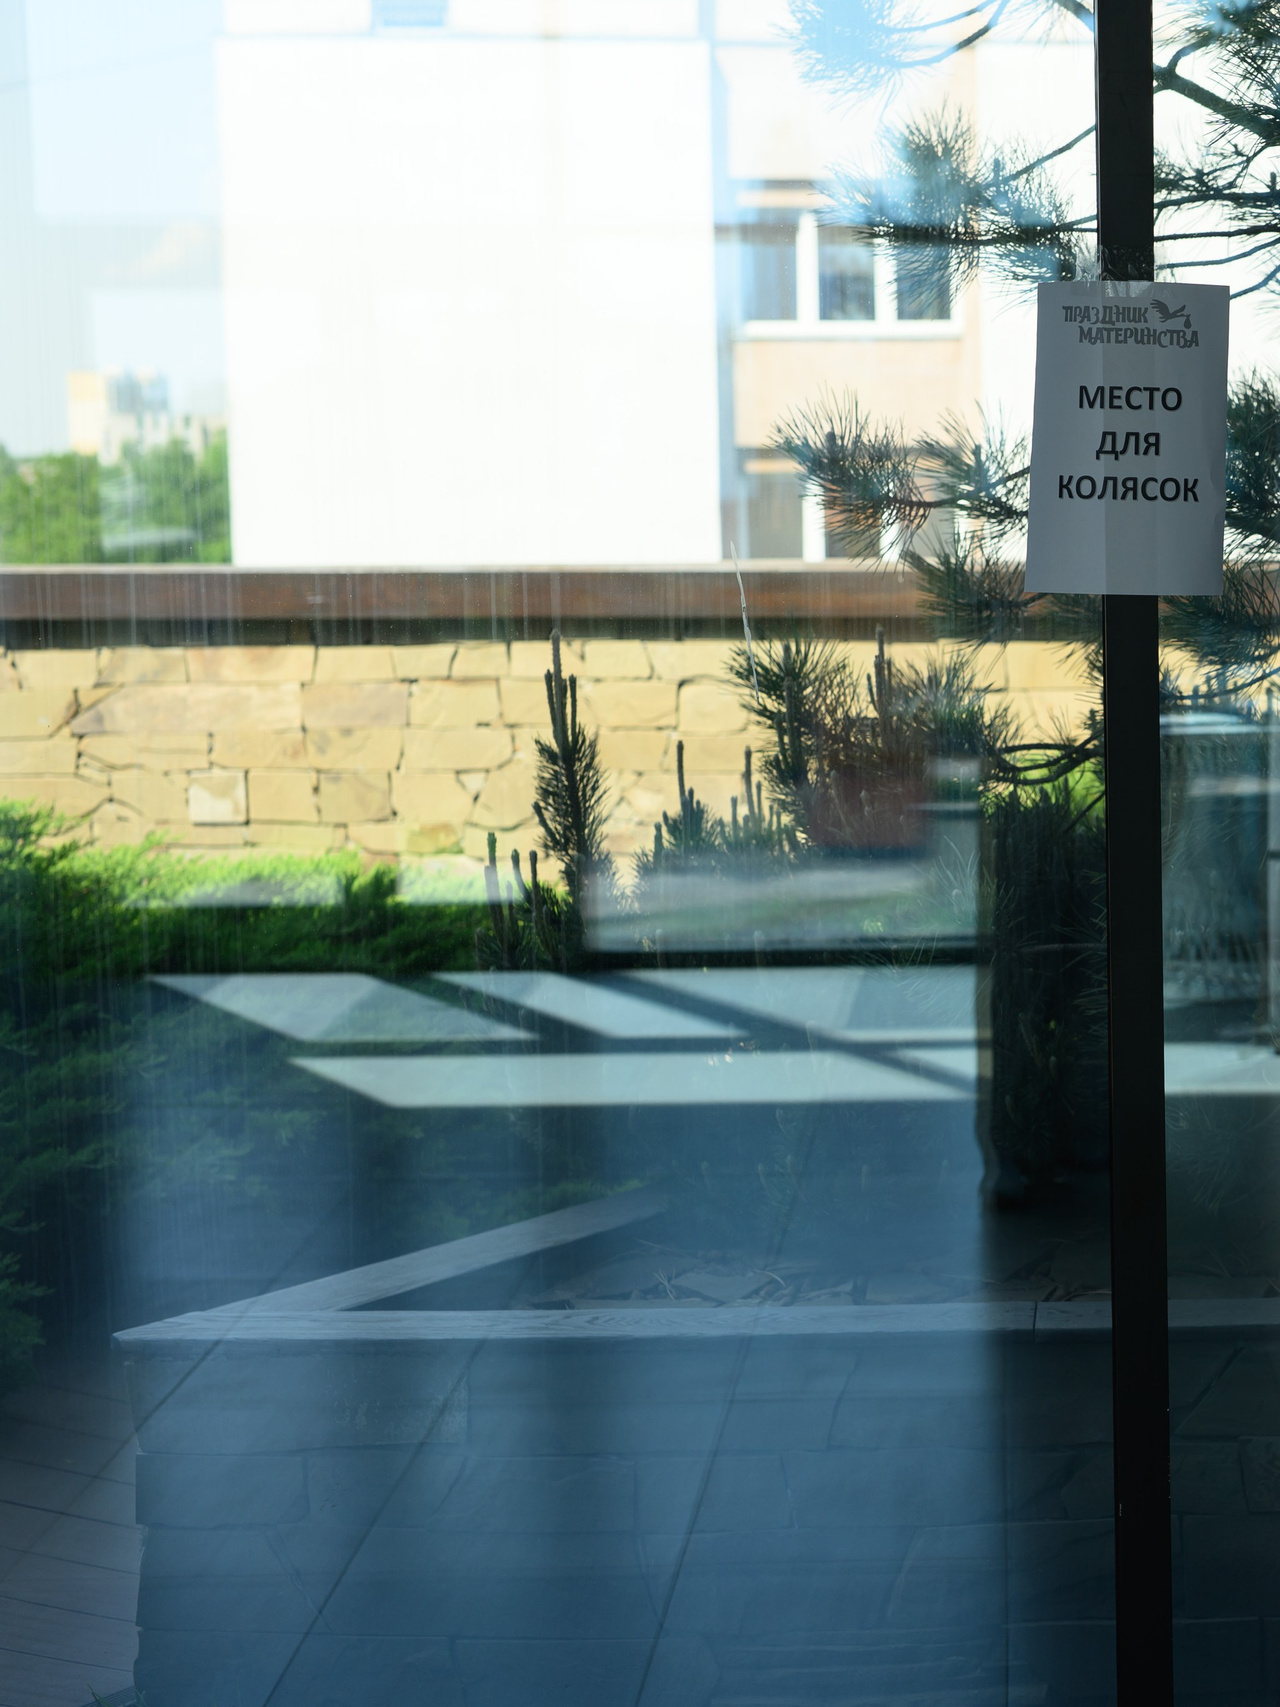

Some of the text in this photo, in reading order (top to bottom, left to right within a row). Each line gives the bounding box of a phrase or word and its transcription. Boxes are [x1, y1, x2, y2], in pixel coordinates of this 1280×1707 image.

[1062, 304, 1149, 327] ПРАЗДНИК
[1078, 325, 1199, 349] МАТЕРИНСТВА
[1078, 385, 1182, 411] МЕСТО
[1096, 431, 1160, 460] ДЛЯ
[1058, 475, 1199, 502] КОЛЯСОК
